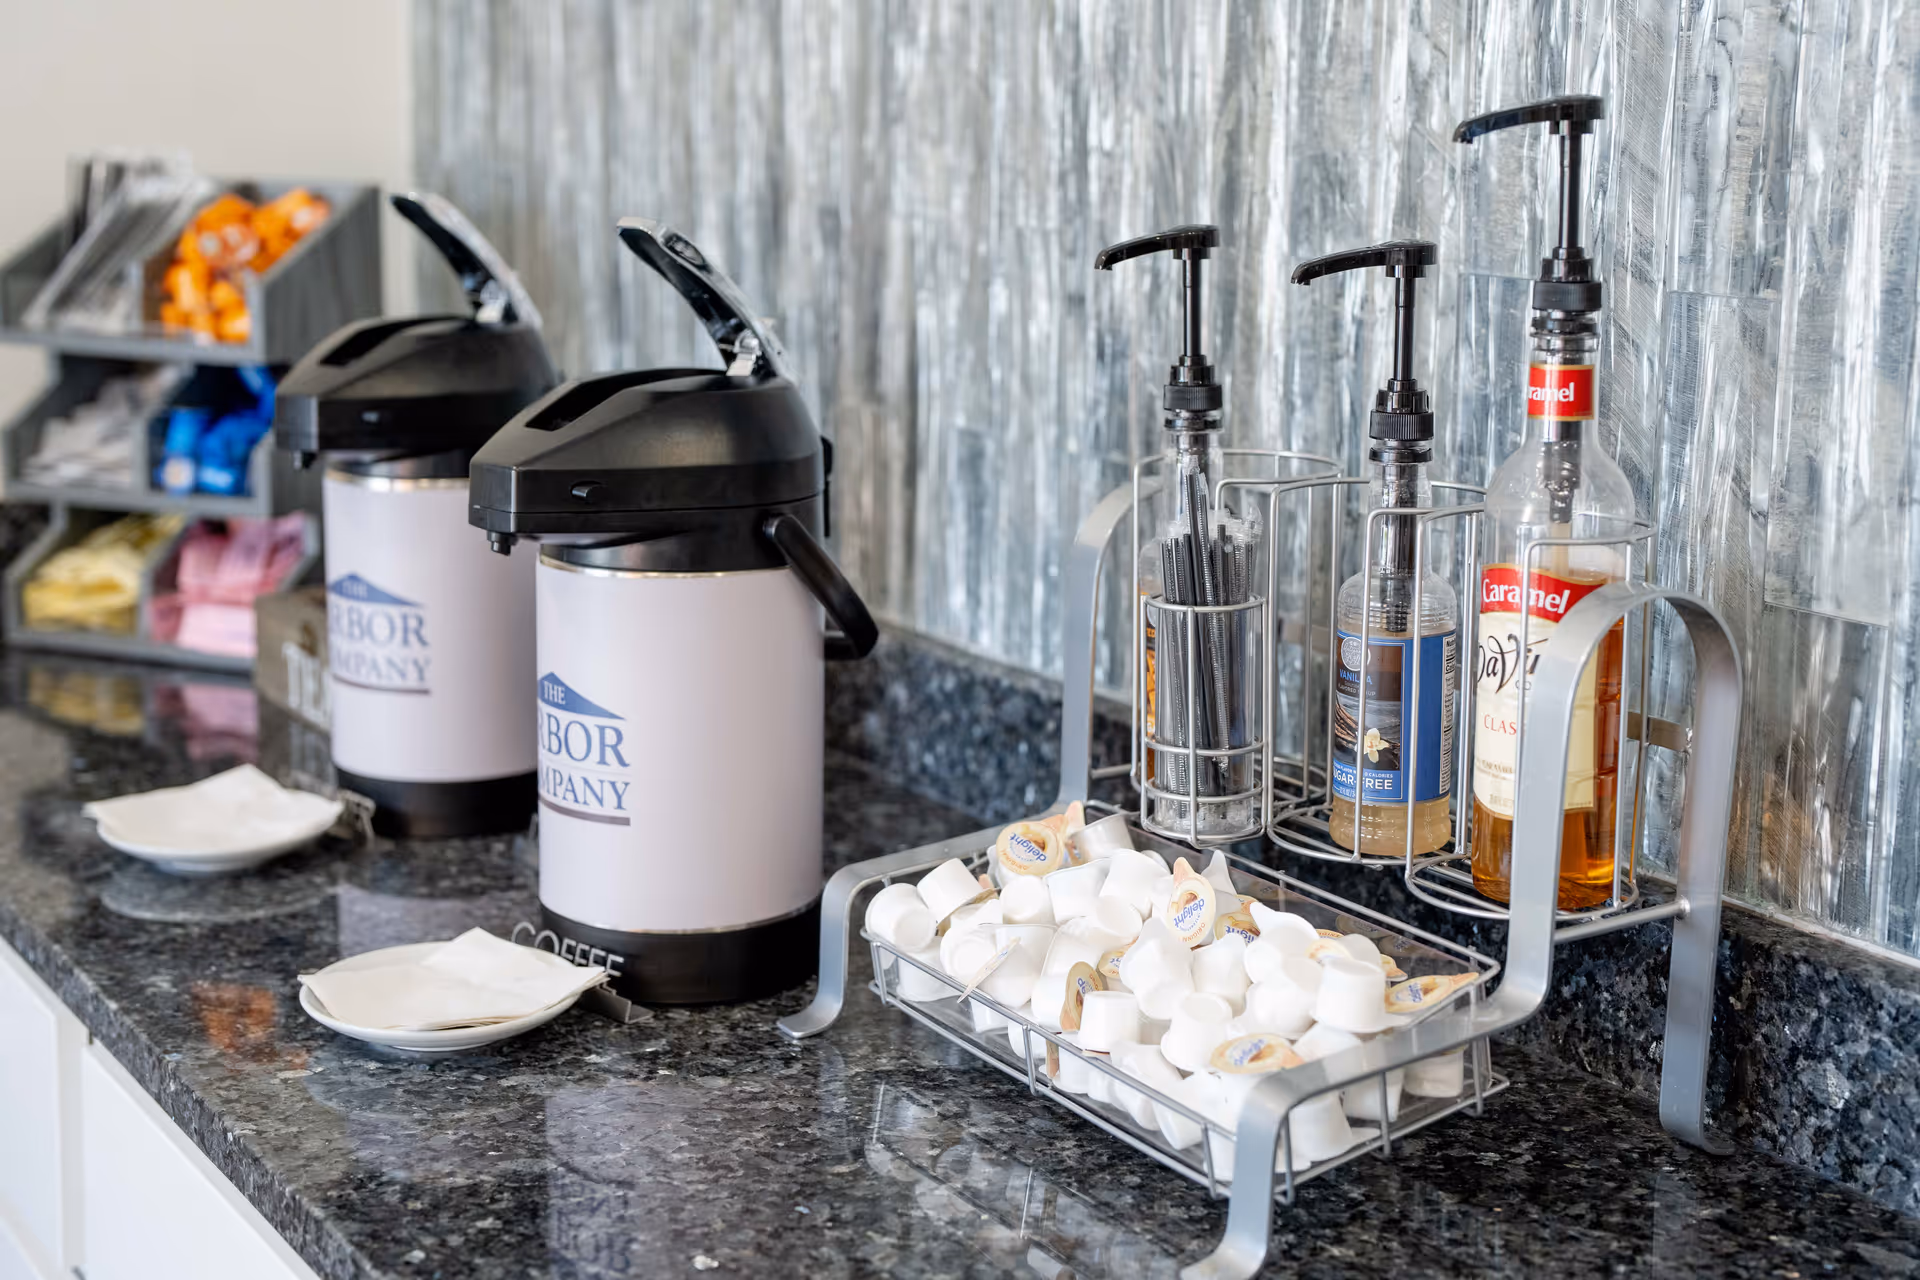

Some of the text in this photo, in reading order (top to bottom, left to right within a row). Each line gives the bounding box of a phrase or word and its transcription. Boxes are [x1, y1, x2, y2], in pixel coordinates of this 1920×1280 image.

[1483, 579, 1571, 614] Caramel
[1339, 668, 1373, 685] VANILA
[543, 681, 566, 705] THE
[1483, 714, 1518, 735] CLAS
[1009, 832, 1047, 862] delight
[1173, 898, 1205, 929] delight
